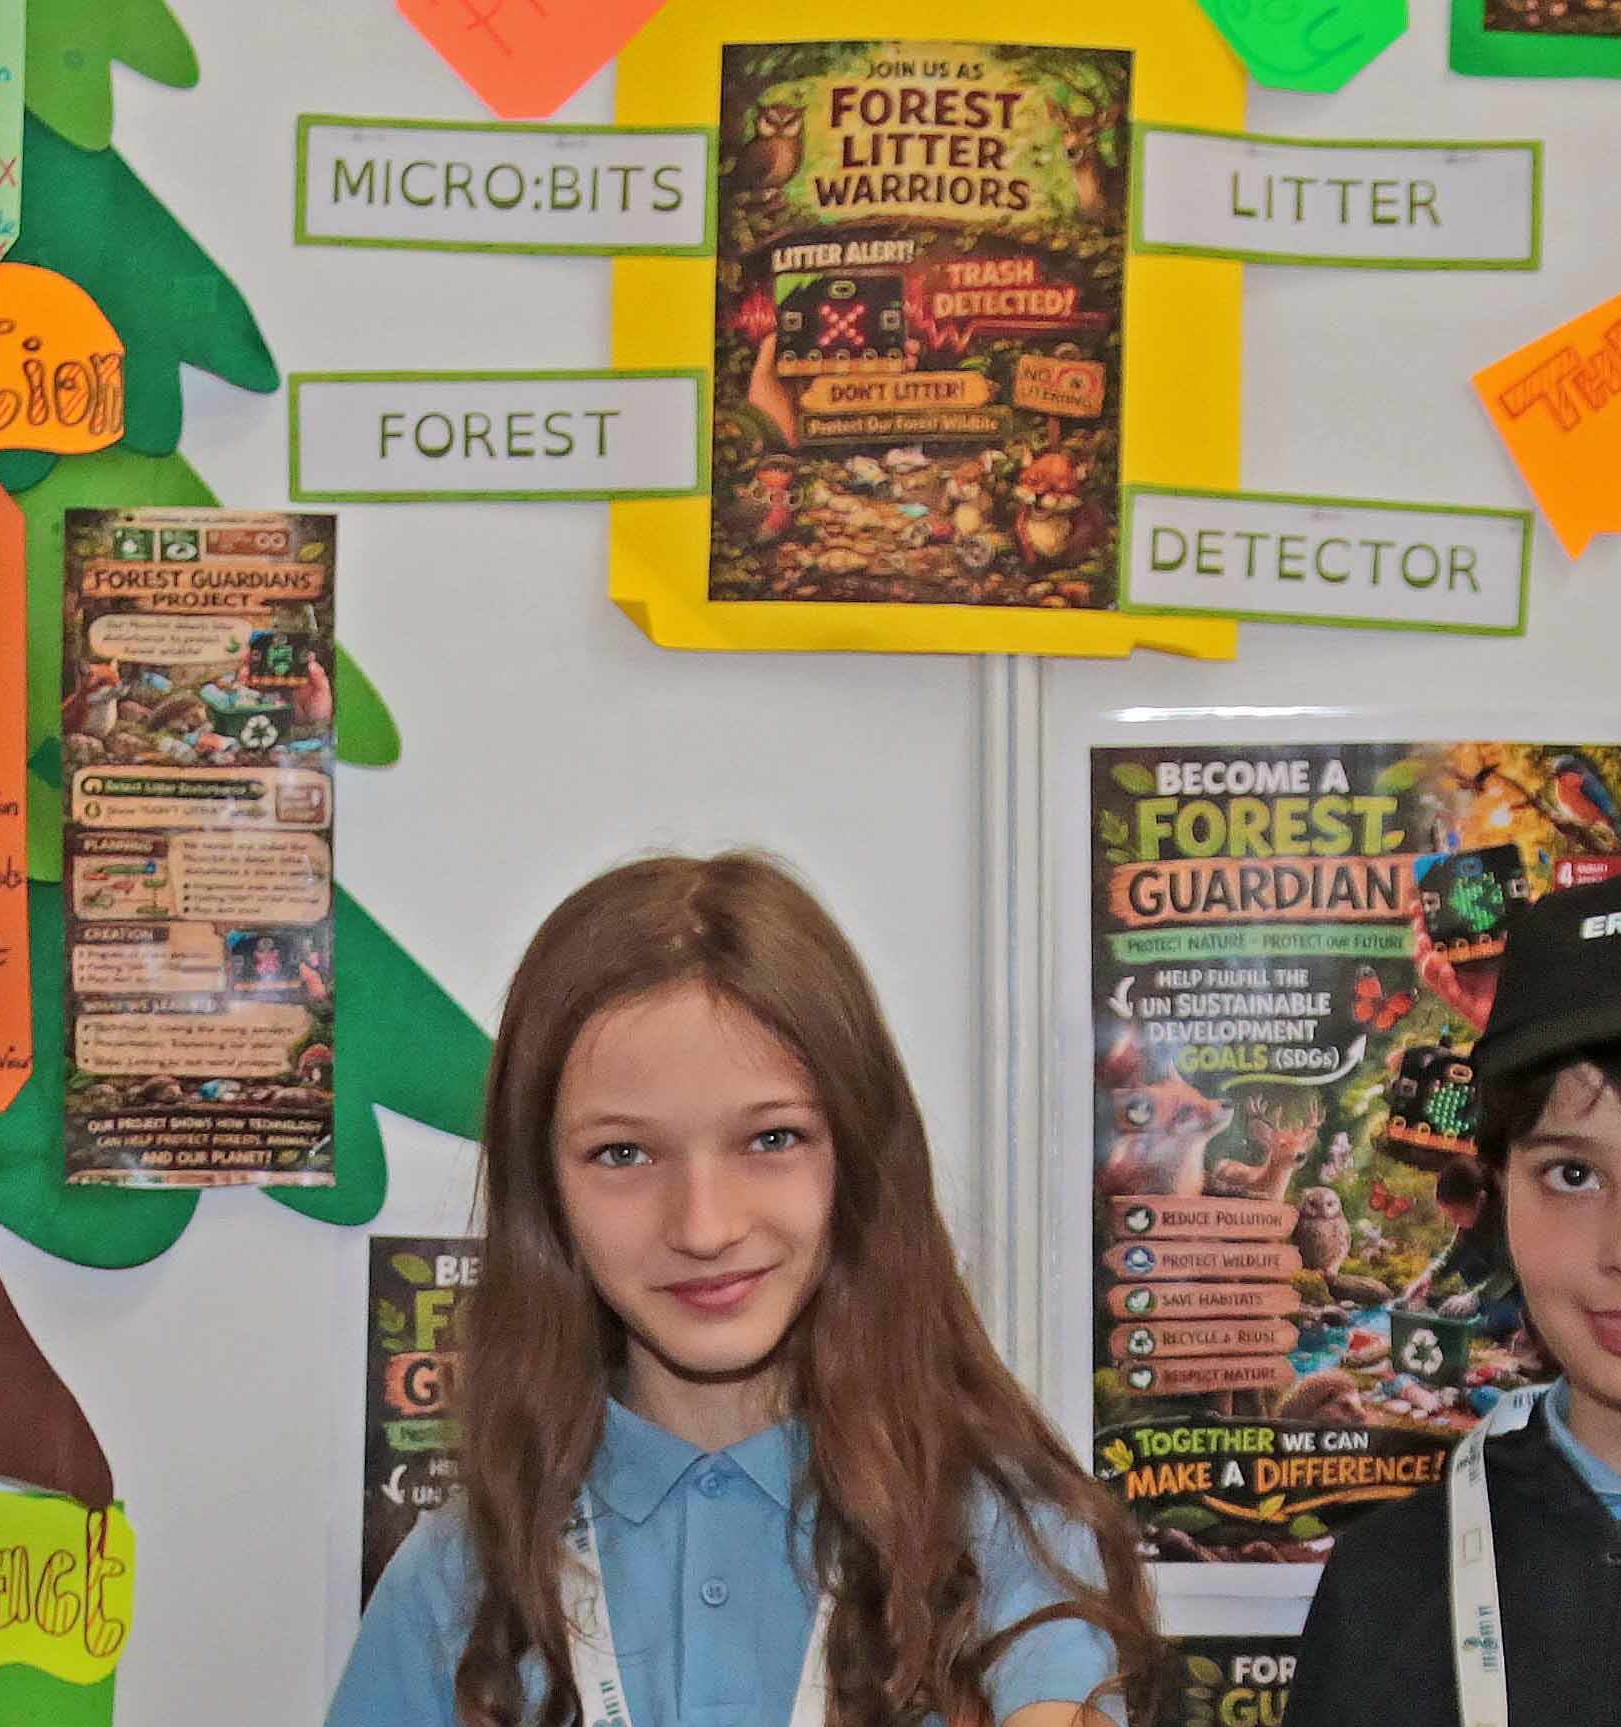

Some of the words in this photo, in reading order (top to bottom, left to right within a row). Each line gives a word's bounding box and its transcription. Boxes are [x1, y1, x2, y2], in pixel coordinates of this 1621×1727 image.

[866, 59, 916, 80] JOIN
[922, 61, 951, 80] US
[958, 61, 985, 80] AS
[830, 86, 1022, 130] FOREST
[841, 133, 1009, 171] LITTER
[332, 159, 685, 212] MICRO:BITS
[814, 175, 1031, 212] WARRIORS
[1232, 172, 1443, 227] LITTER
[772, 245, 843, 272] LITTER
[950, 260, 1035, 287] TRASH
[933, 289, 1076, 318] DETECTED!
[831, 381, 888, 404] DON'T
[893, 380, 966, 402] LITTER!
[379, 411, 622, 458] FOREST
[1150, 527, 1481, 593] DETECTOR
[94, 569, 181, 589] FOREST
[192, 570, 312, 590] GUARDIANS
[152, 591, 253, 608] PROJECT
[1156, 760, 1310, 797] BECOME
[1320, 760, 1350, 793] A
[1134, 796, 1399, 861] FOREST
[1128, 861, 1401, 918] GUARDIAN
[1156, 969, 1204, 989] HELP
[1207, 969, 1269, 988] FULFILL
[1275, 969, 1309, 987] THE
[1140, 997, 1172, 1017] UN
[1177, 993, 1331, 1017] SUSTAINABLE
[1146, 1019, 1317, 1043] DEVELOPMENT
[1178, 1046, 1268, 1072] GOALS
[1275, 1047, 1341, 1072] (SDGs)
[1135, 1427, 1274, 1457] TOGETHER
[1282, 1433, 1315, 1452] WE
[1324, 1432, 1369, 1449] CAN
[1126, 1460, 1212, 1498] MAKE
[1221, 1464, 1245, 1487] A
[1253, 1449, 1448, 1493] DIFFERENCE!
